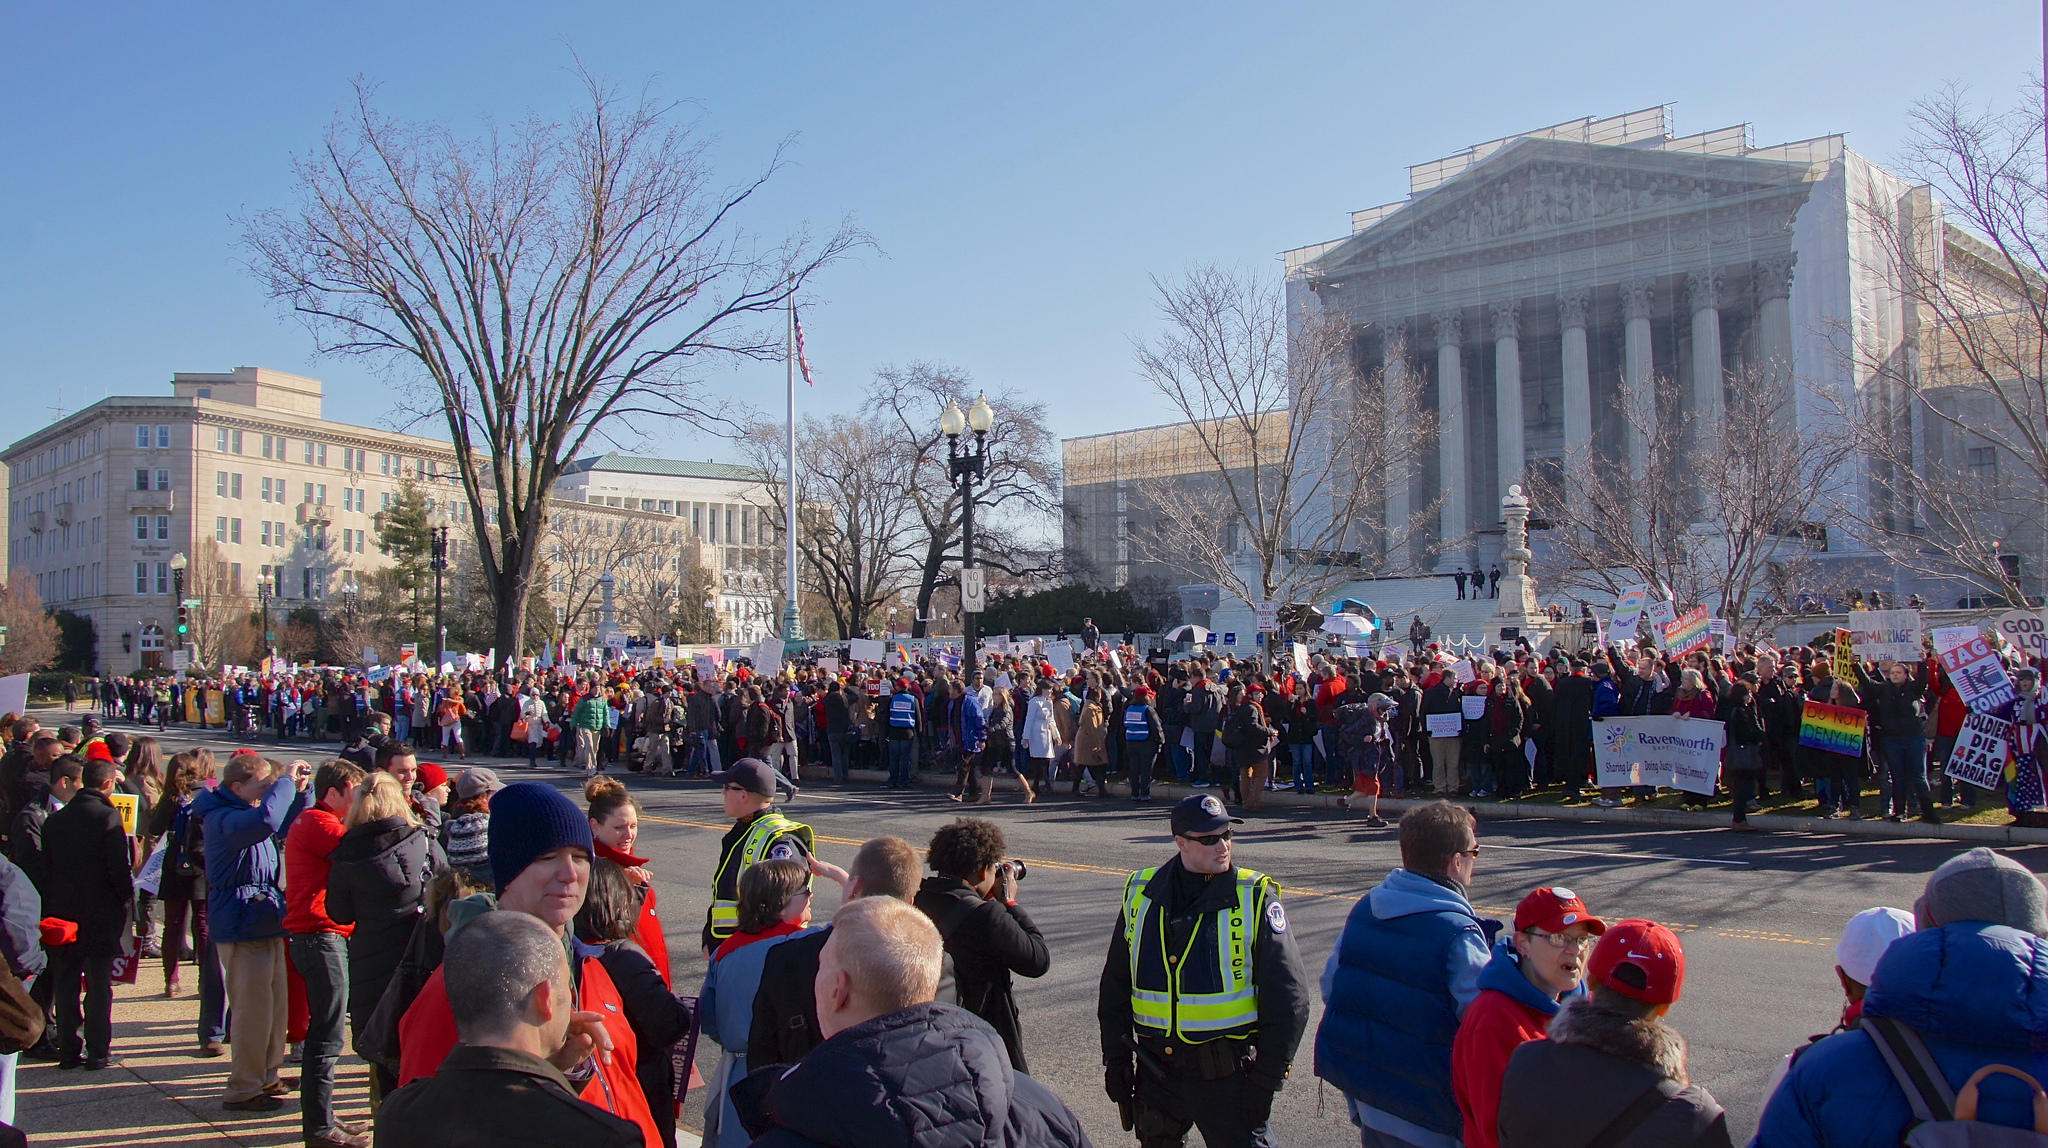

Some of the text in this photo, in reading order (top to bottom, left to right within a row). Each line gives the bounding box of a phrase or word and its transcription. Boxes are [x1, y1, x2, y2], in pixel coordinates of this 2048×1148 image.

[966, 571, 979, 582] NO
[966, 582, 979, 599] U
[965, 599, 981, 610] TURN
[1650, 604, 1667, 612] HATE
[1667, 620, 1682, 634] GOD
[1683, 611, 1697, 625] HAS
[2002, 618, 2044, 634] GOD
[1671, 631, 1707, 658] BELOVED
[1865, 628, 1915, 645] MARRIAGE
[1943, 639, 1988, 669] FAG
[868, 683, 880, 691] 100
[1970, 684, 2016, 715] COURT
[1806, 704, 1861, 728] DO NOT
[1638, 732, 1714, 752] Ravensworth
[1803, 723, 1843, 745] DENY
[1970, 733, 1998, 754] DIE
[1605, 761, 1626, 775] Sharing
[1644, 760, 1659, 774] Doing
[1965, 748, 2003, 772] FAG
[1947, 758, 1998, 788] MARRIAGE
[1230, 905, 1244, 981] POLICE
